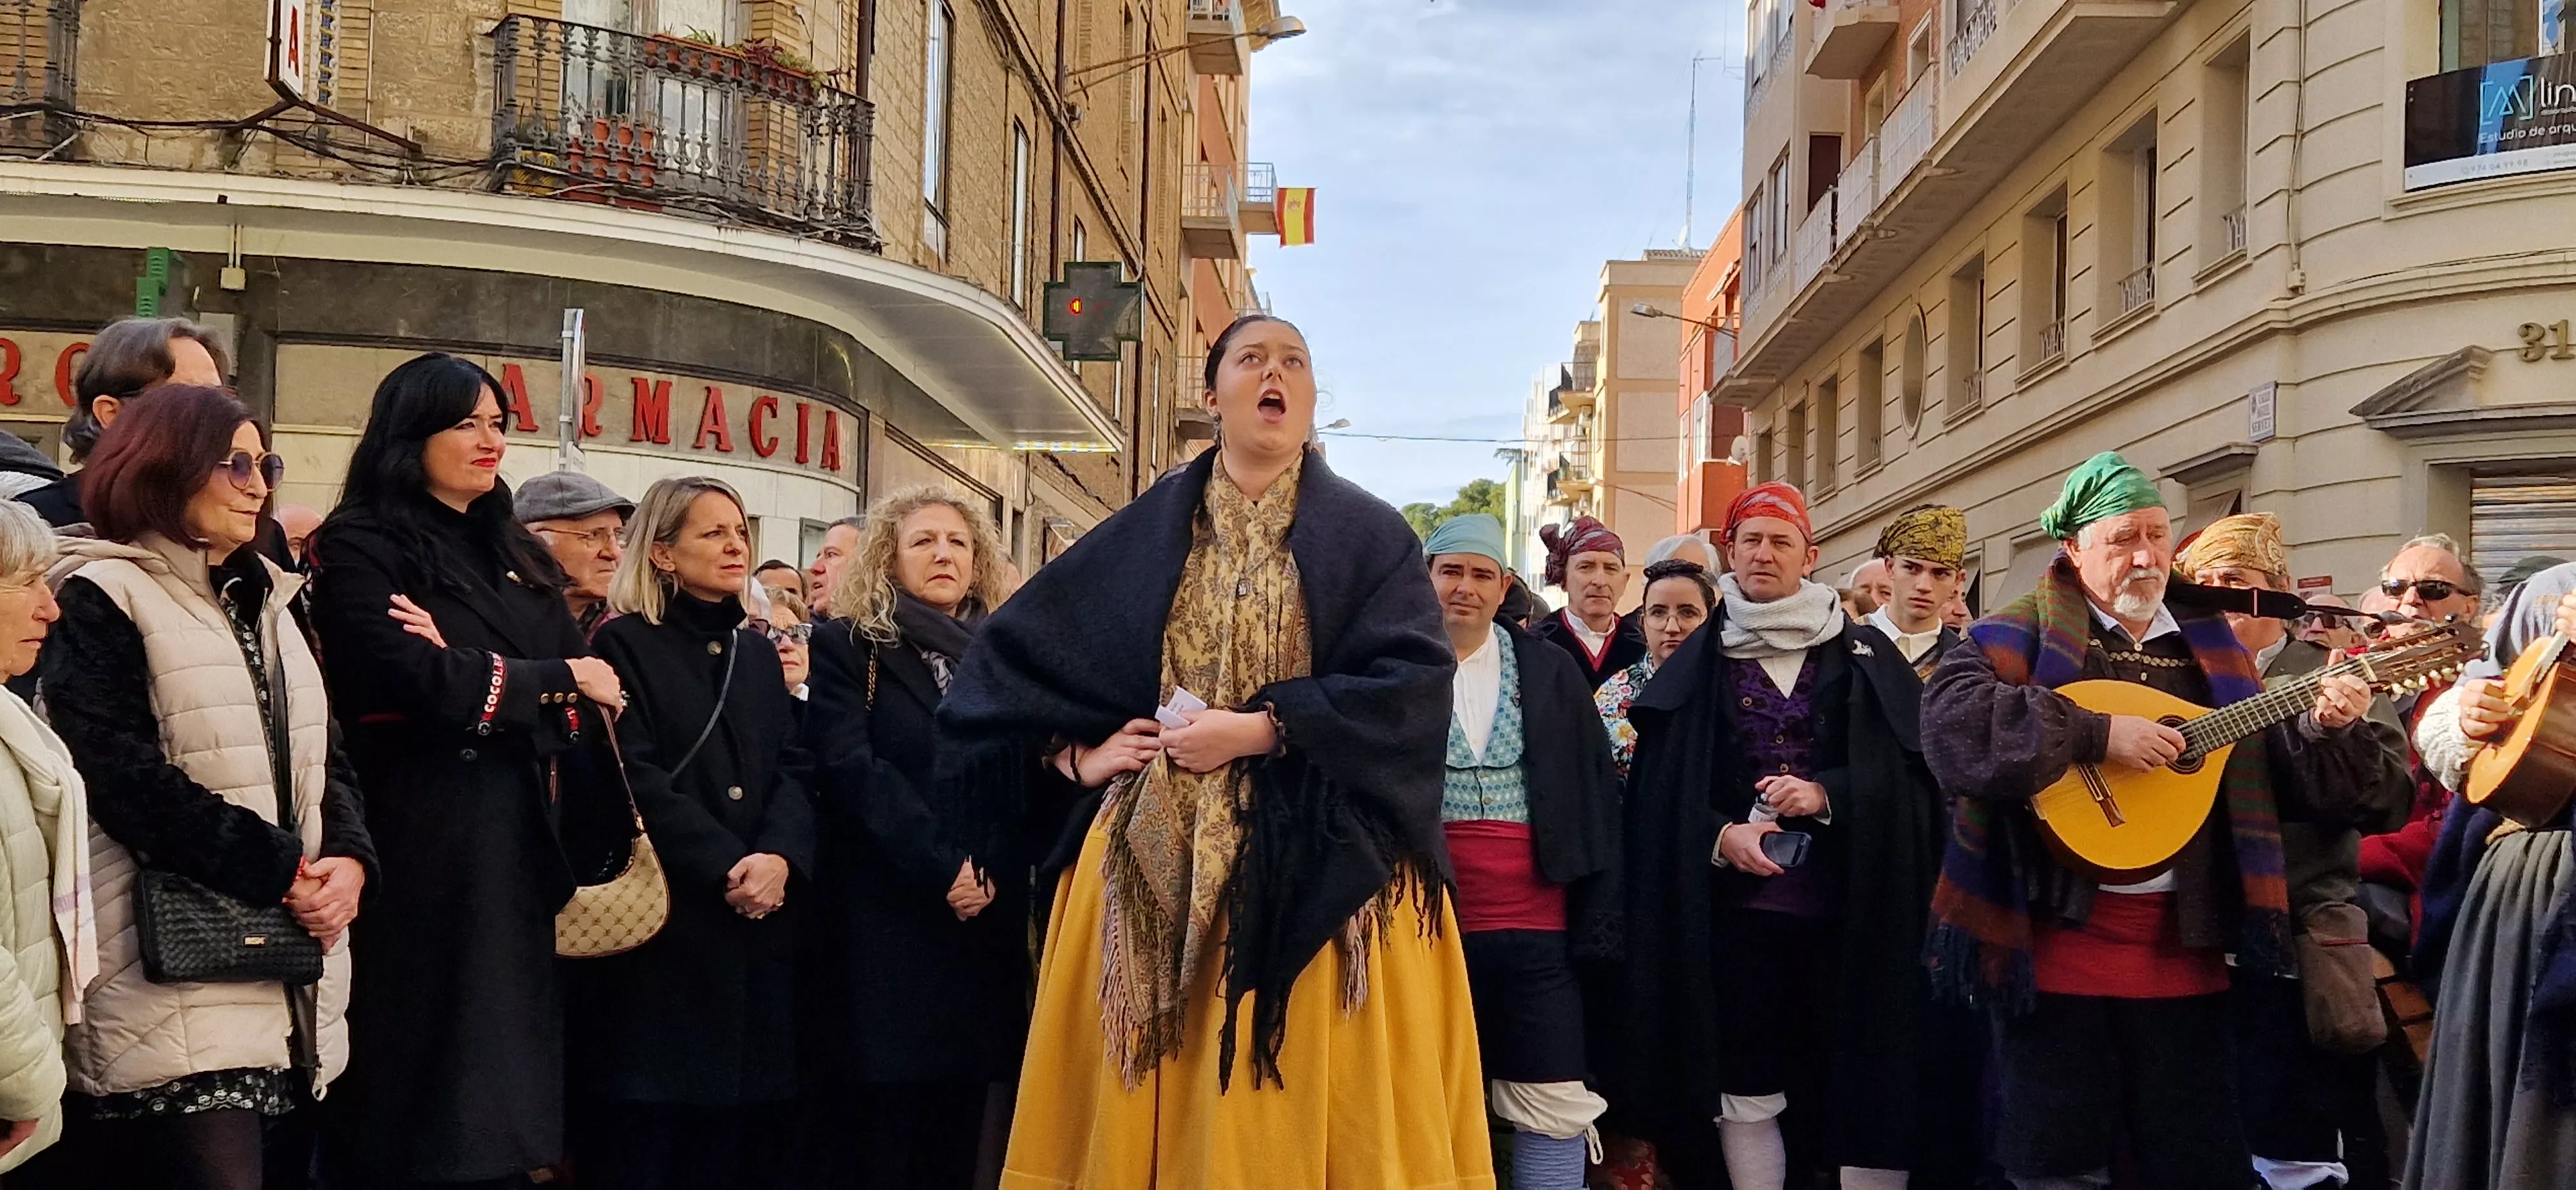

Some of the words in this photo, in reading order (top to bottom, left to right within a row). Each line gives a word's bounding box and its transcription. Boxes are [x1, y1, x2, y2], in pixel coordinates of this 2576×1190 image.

[2480, 127, 2526, 144] Estudio
[2528, 126, 2546, 137] de
[2517, 319, 2575, 363] 31
